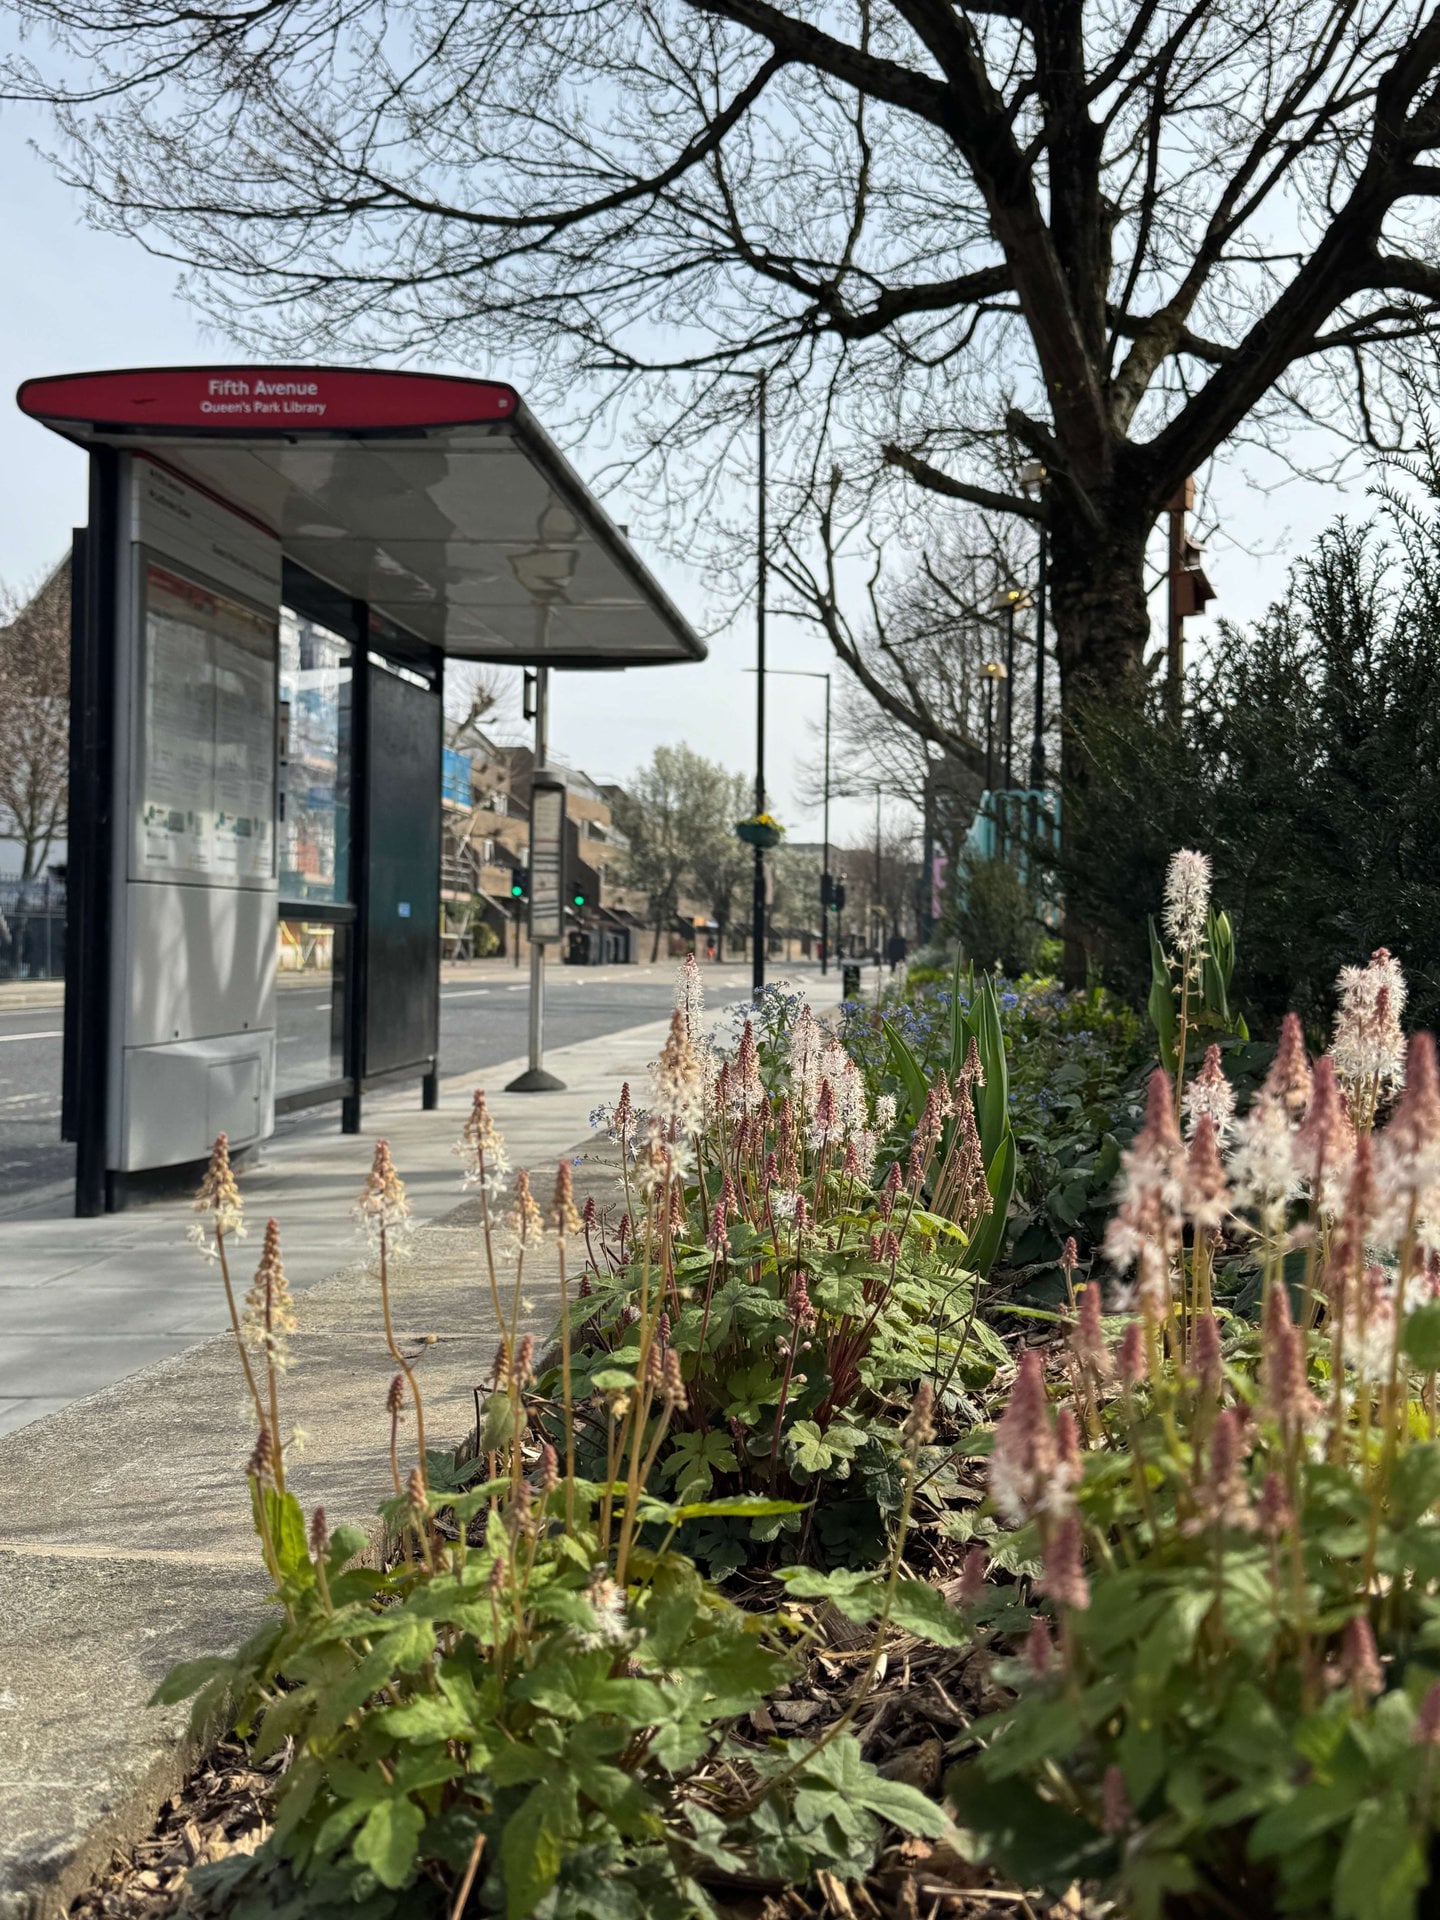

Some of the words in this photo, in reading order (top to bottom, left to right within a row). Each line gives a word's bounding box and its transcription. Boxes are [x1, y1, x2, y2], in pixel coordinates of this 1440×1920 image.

[208, 379, 250, 396] Fifth
[254, 380, 318, 396] Avenue
[199, 400, 252, 414] Queen's
[254, 401, 281, 414] Park
[283, 401, 327, 416] Library
